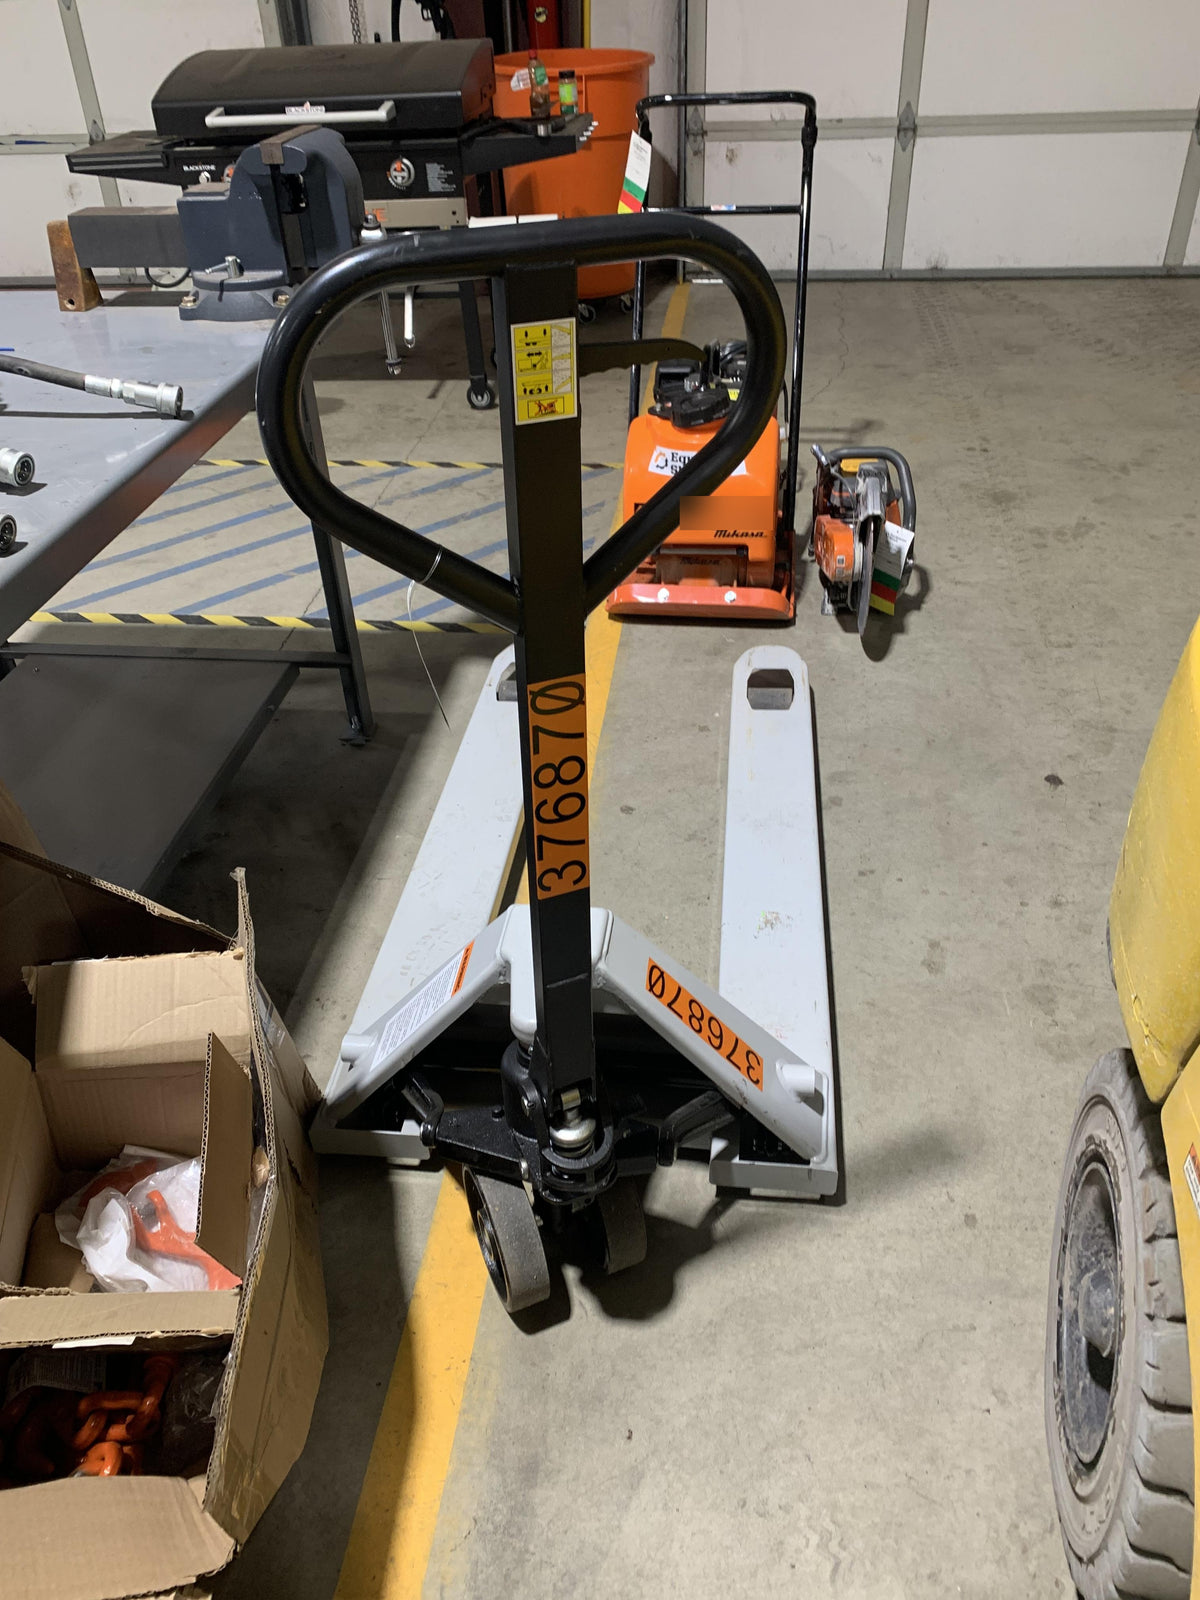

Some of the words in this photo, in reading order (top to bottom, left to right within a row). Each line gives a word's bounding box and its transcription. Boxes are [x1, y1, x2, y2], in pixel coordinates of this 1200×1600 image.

[713, 529, 764, 538] Mikasa
[530, 681, 587, 892] 376870
[648, 964, 761, 1085] 376870
